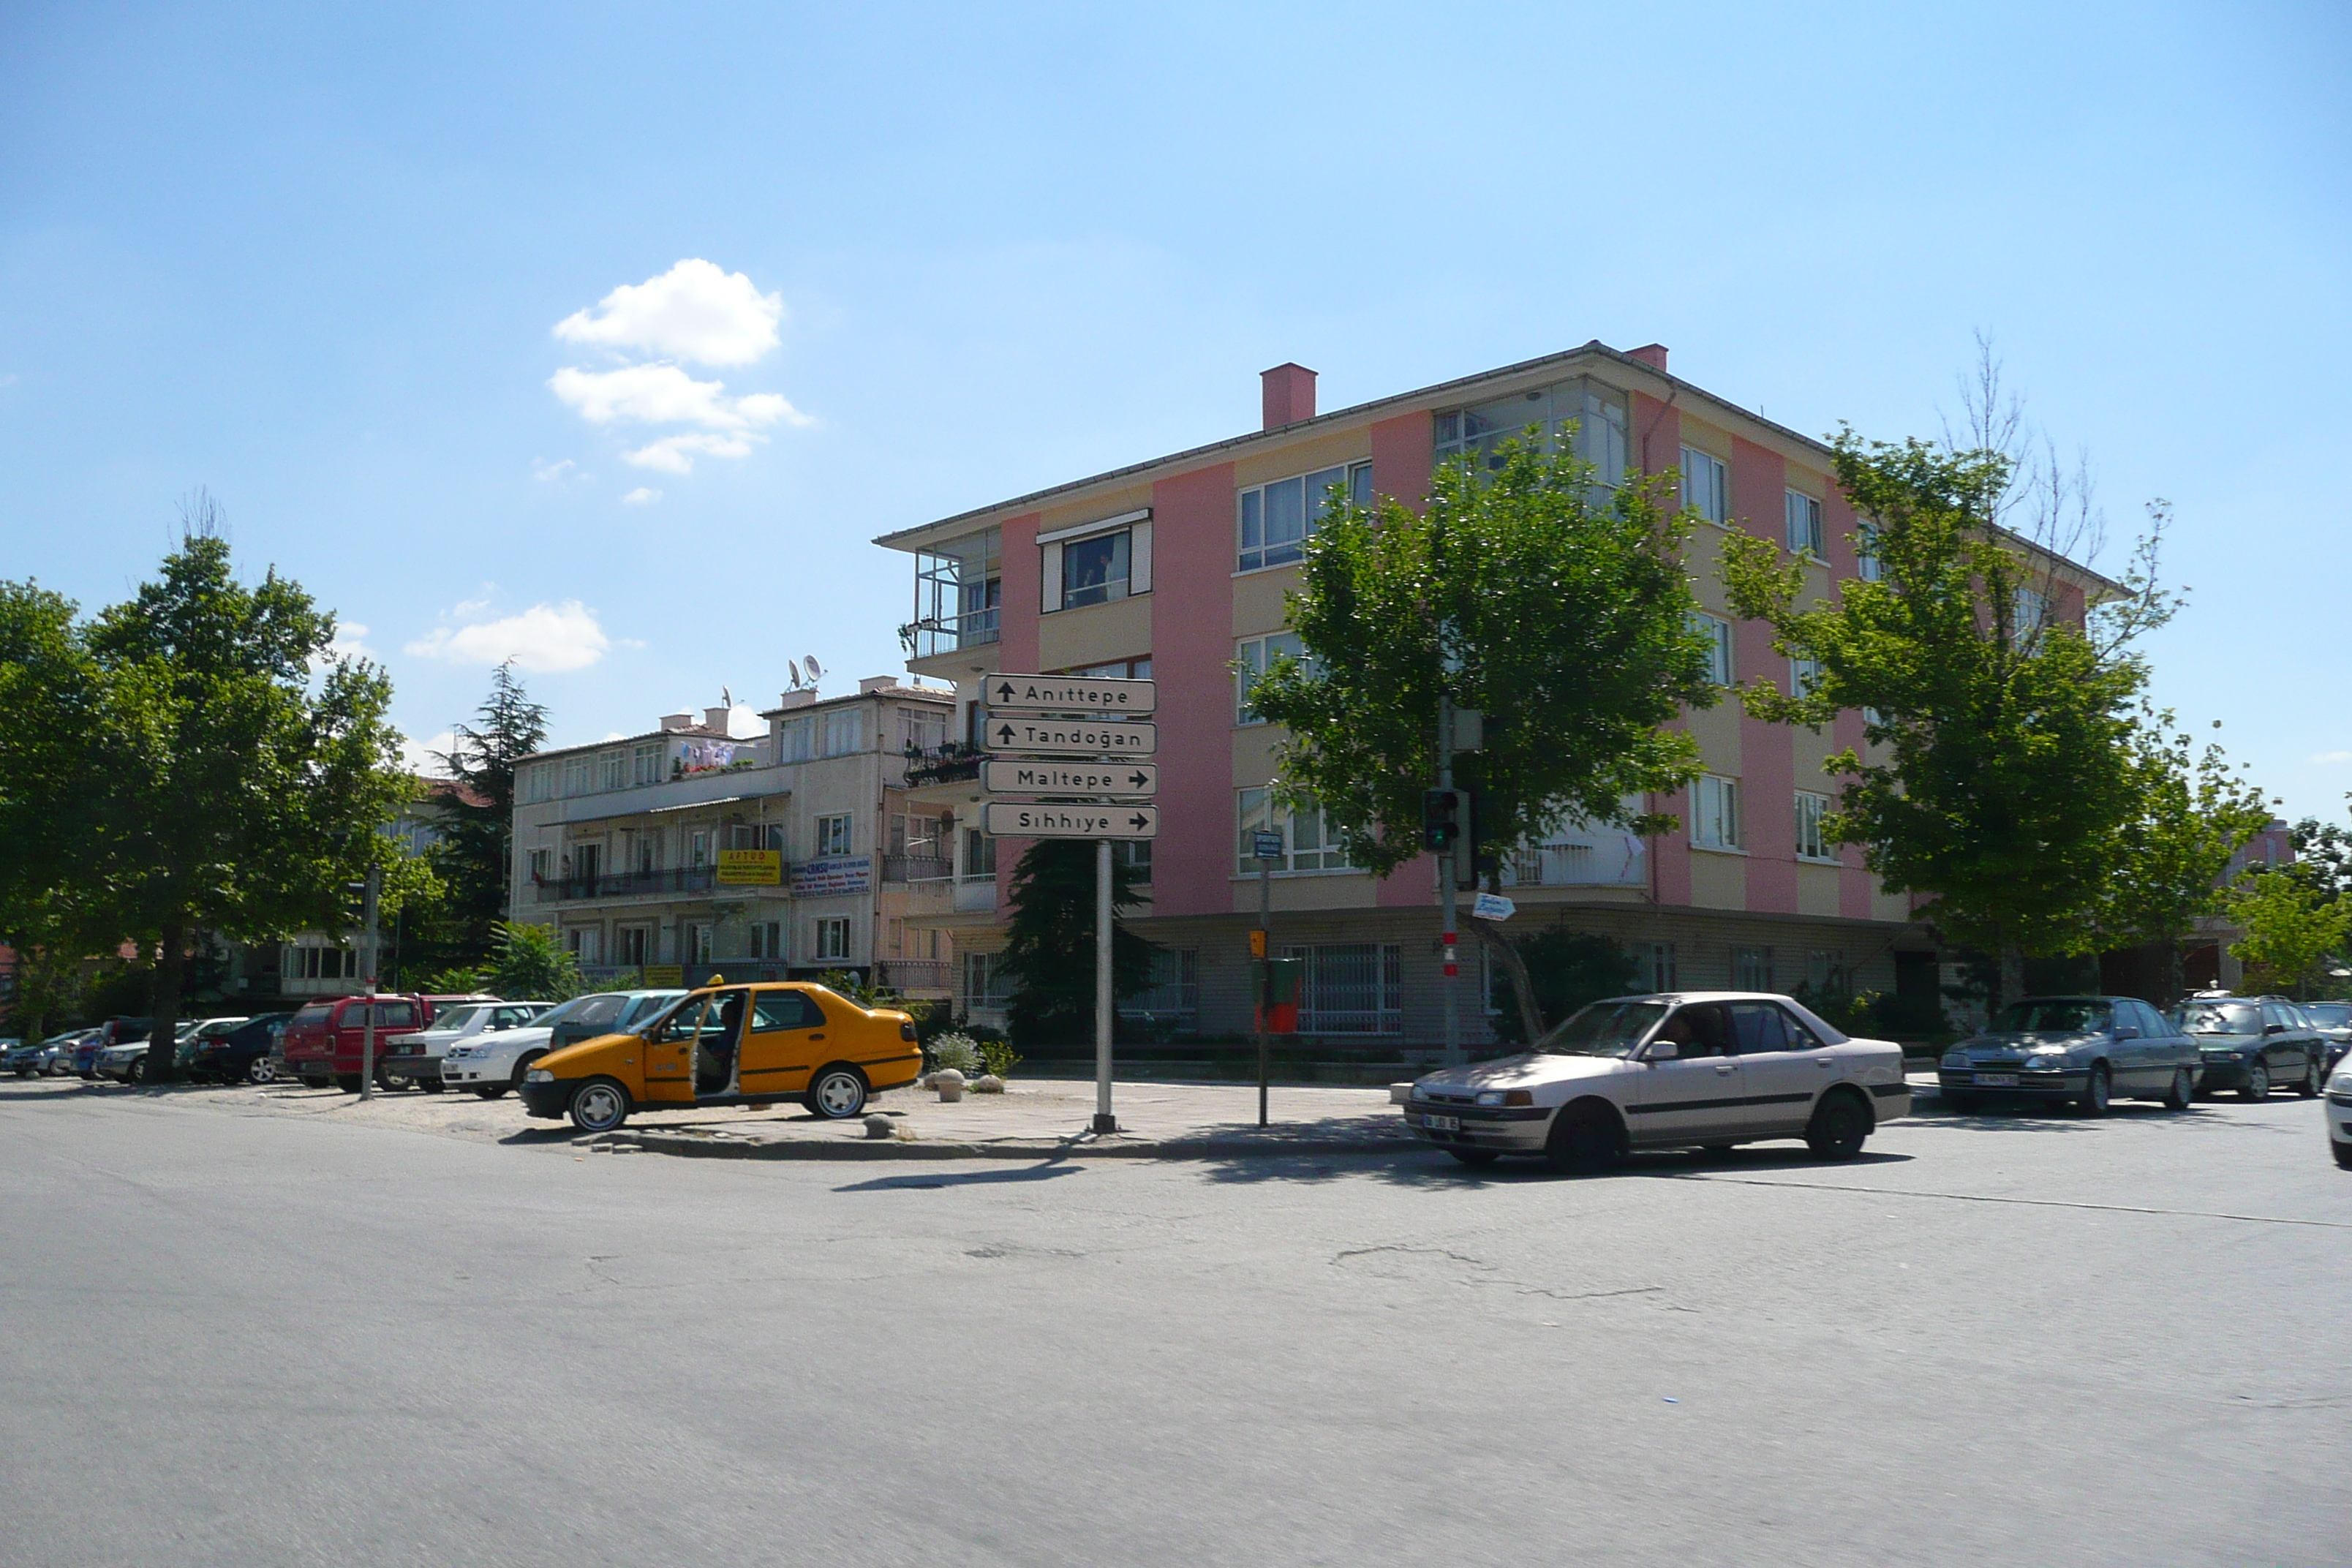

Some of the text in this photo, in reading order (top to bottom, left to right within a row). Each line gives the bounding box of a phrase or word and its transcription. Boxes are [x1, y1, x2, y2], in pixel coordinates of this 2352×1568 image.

[1025, 685, 1128, 706] Anıttepe
[1025, 727, 1141, 748] Tandoğan
[1017, 770, 1113, 789] Maltepe
